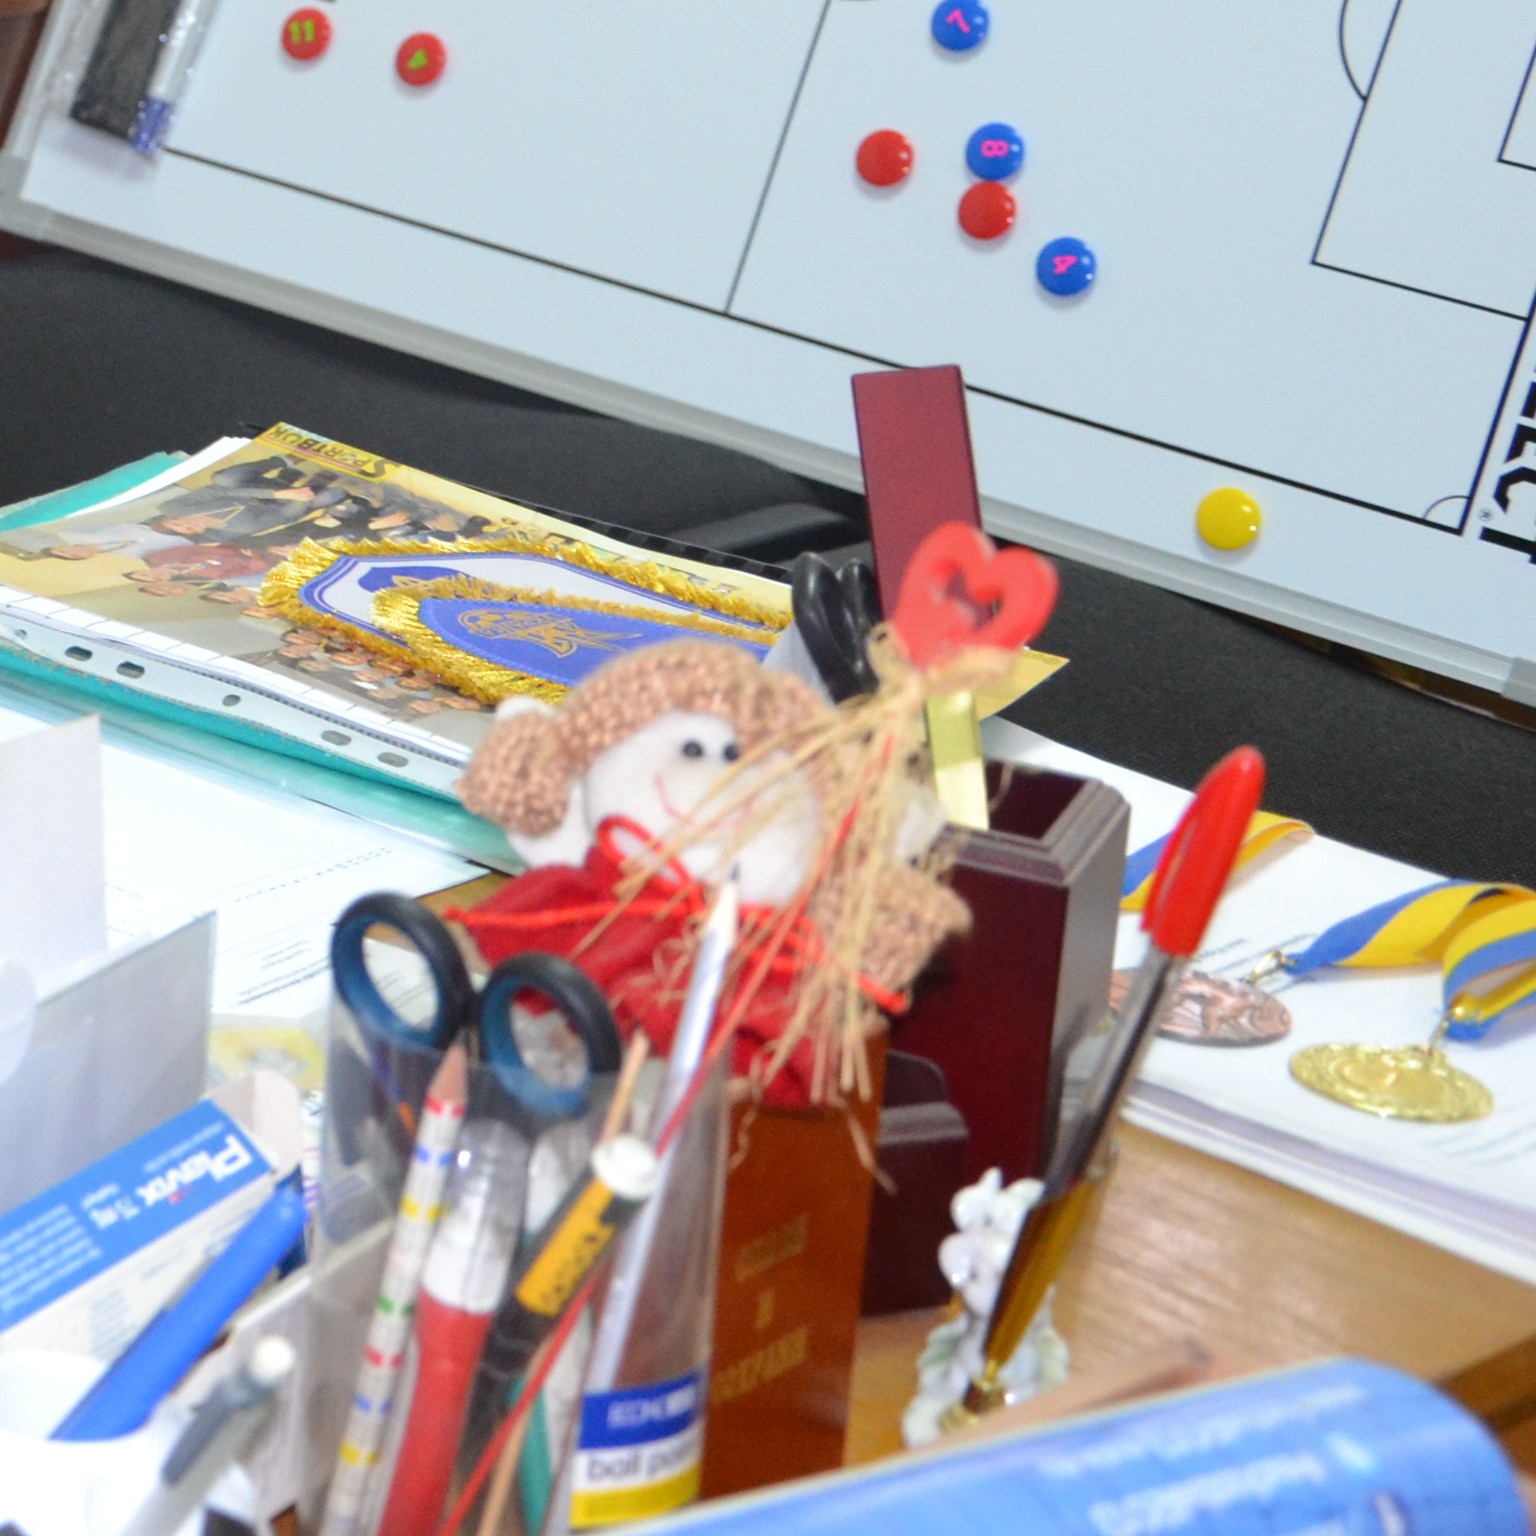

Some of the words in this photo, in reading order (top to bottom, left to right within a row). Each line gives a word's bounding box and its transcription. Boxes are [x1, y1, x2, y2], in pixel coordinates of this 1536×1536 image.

[290, 20, 314, 43] 11
[946, 9, 970, 33] 7
[980, 139, 1009, 158] 8
[1052, 255, 1077, 275] 4
[268, 425, 403, 478] SPORTBUK
[134, 1133, 253, 1208] Plavix
